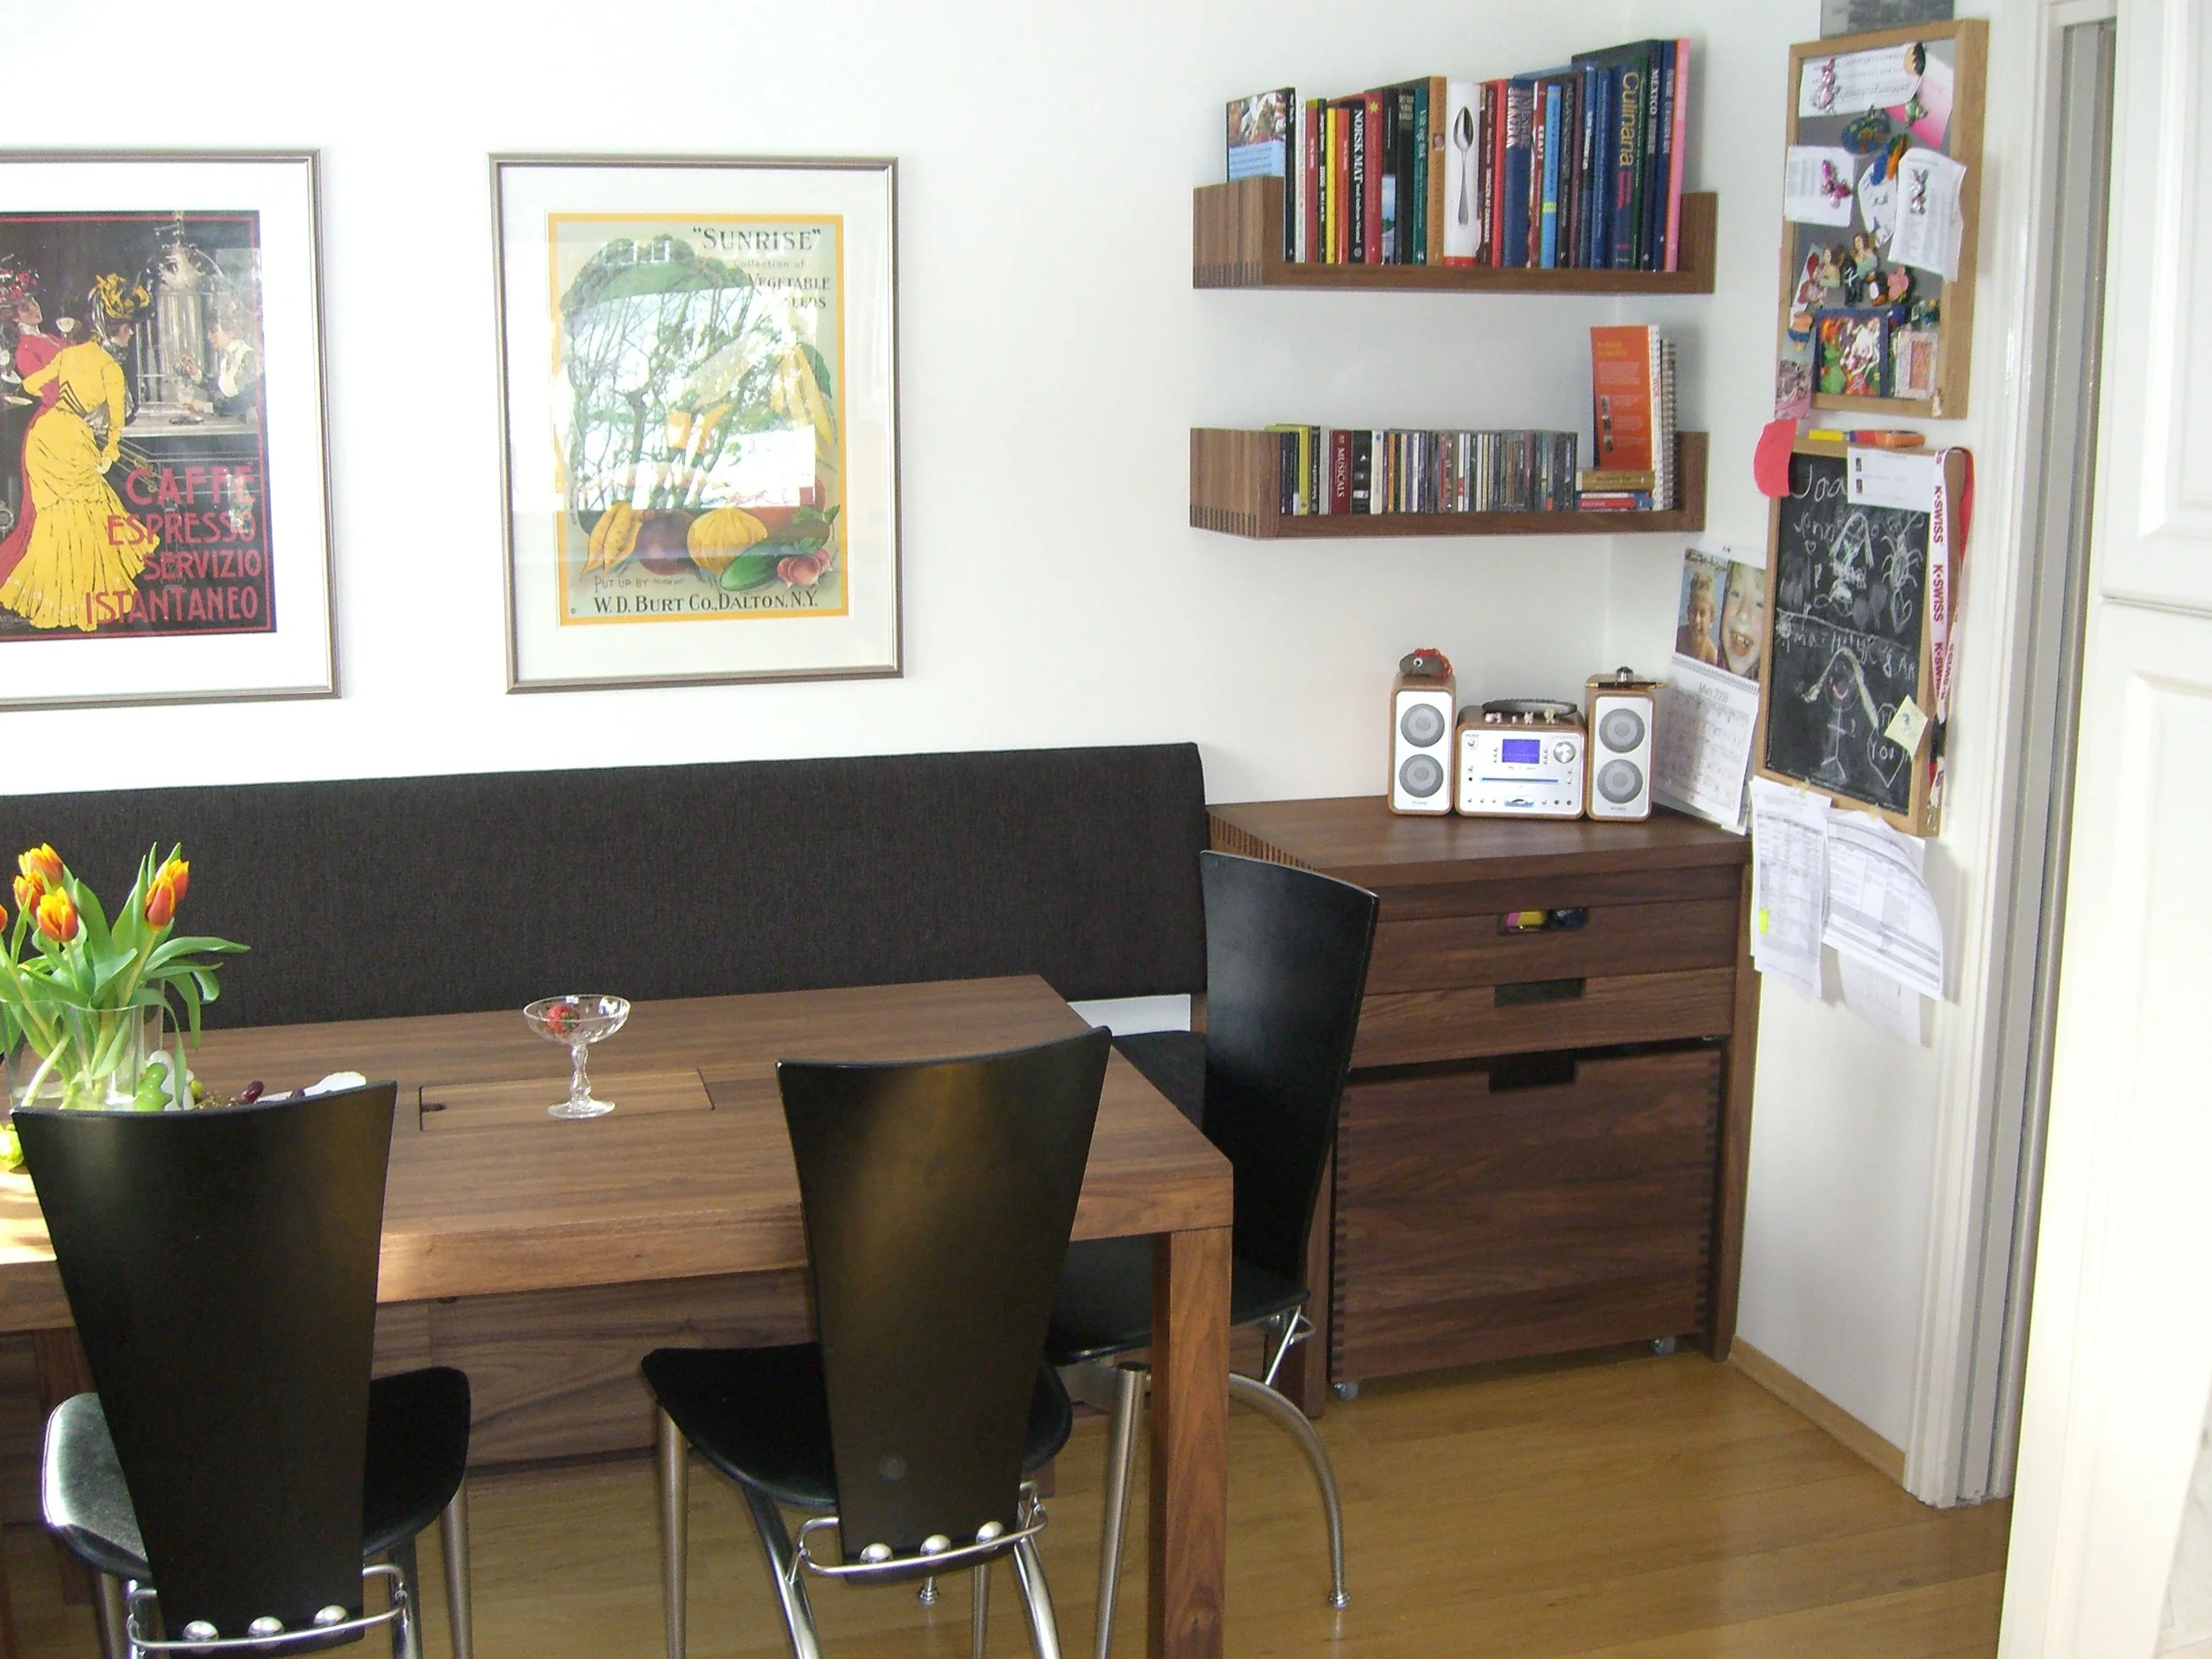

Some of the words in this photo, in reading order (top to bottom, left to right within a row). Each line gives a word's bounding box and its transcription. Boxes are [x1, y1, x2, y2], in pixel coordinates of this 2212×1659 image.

[1355, 109, 1363, 152] NORSK
[1619, 72, 1640, 167] Culinaria
[1355, 154, 1363, 183] MAT
[1337, 447, 1346, 498] MUSICALS
[106, 510, 257, 546] ESPRESSO
[142, 549, 262, 580] SERVIZIO
[618, 579, 632, 588] UP
[634, 578, 649, 588] BY
[85, 586, 258, 625] ISTANTANEO
[594, 595, 612, 614] W.
[616, 595, 632, 613] D.
[635, 594, 684, 612] BURT
[790, 589, 818, 608] N.Y.
